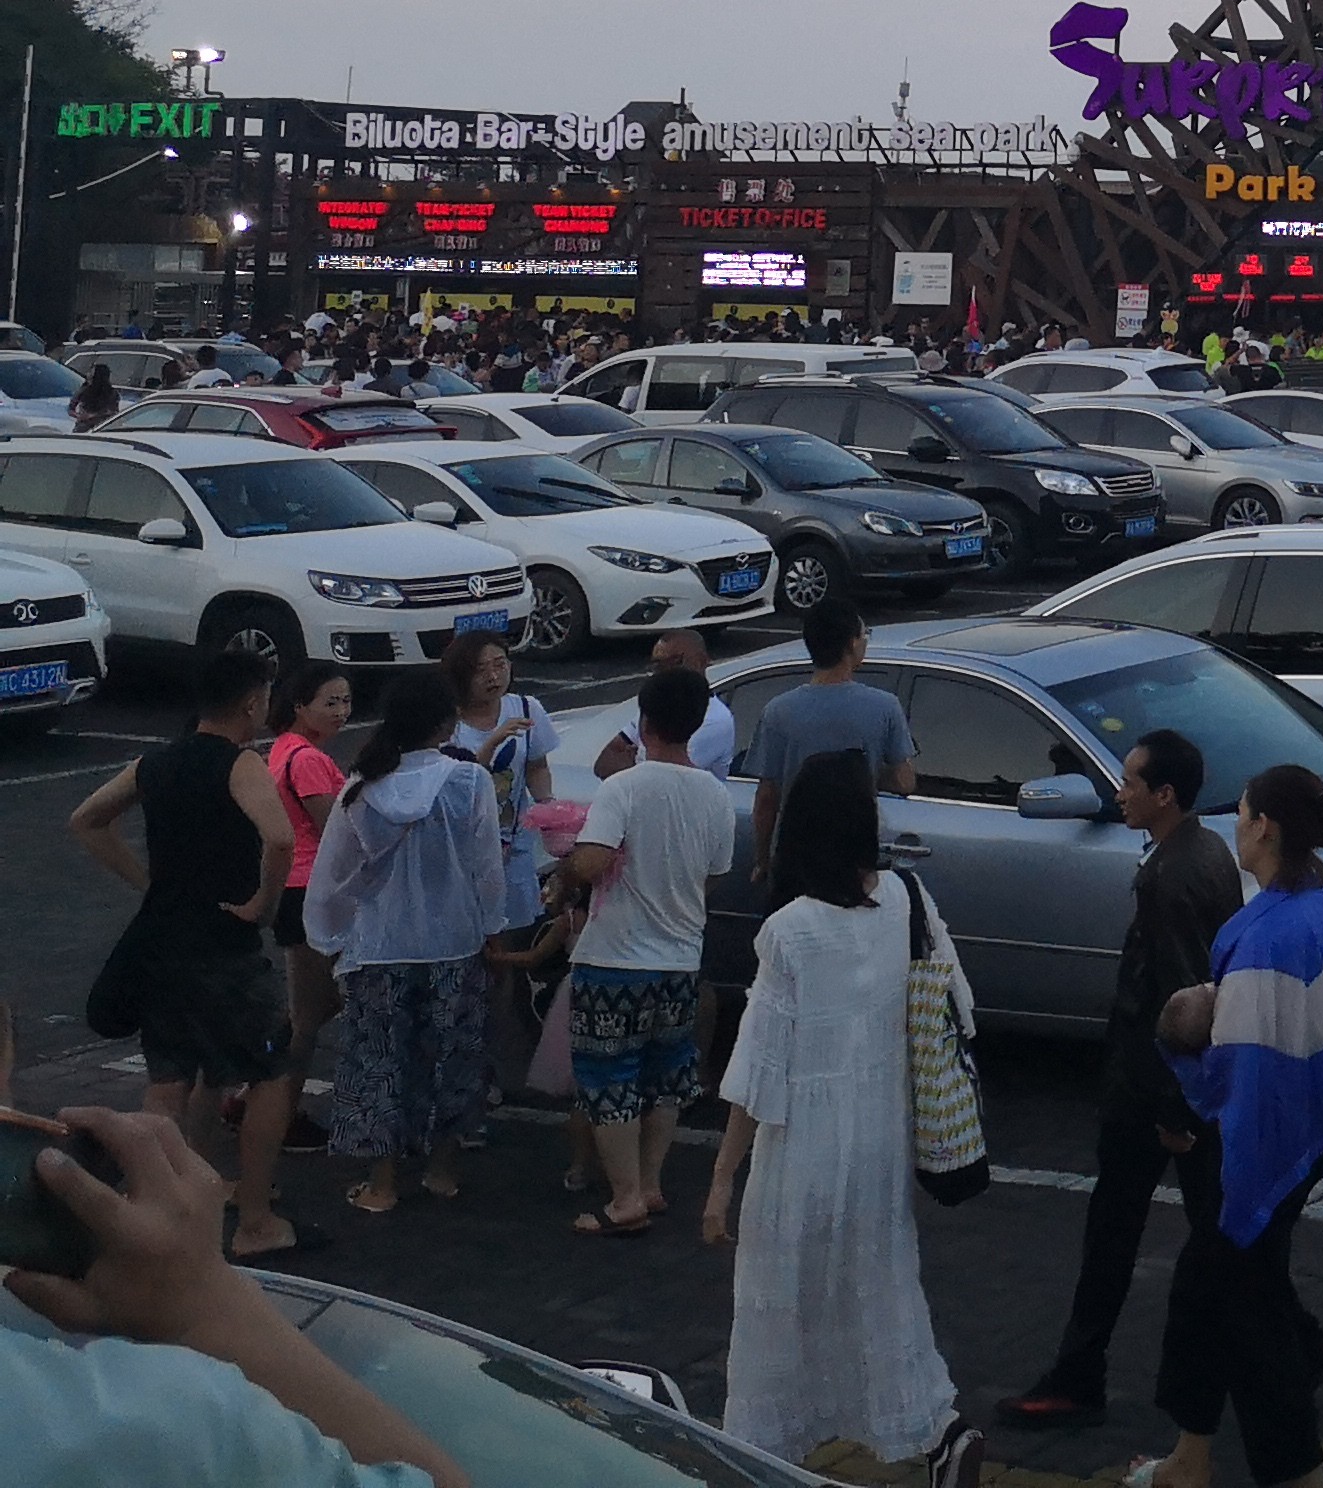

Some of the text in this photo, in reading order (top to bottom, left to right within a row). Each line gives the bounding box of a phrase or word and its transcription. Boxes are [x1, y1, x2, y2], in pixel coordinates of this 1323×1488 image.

[130, 102, 222, 138] EXIT
[346, 113, 460, 149] Biluota
[554, 113, 646, 161] Style
[663, 120, 871, 152] amusement
[888, 121, 957, 152] sea
[974, 115, 1057, 161] park
[1204, 163, 1316, 204] Park
[679, 207, 753, 229] TICKET
